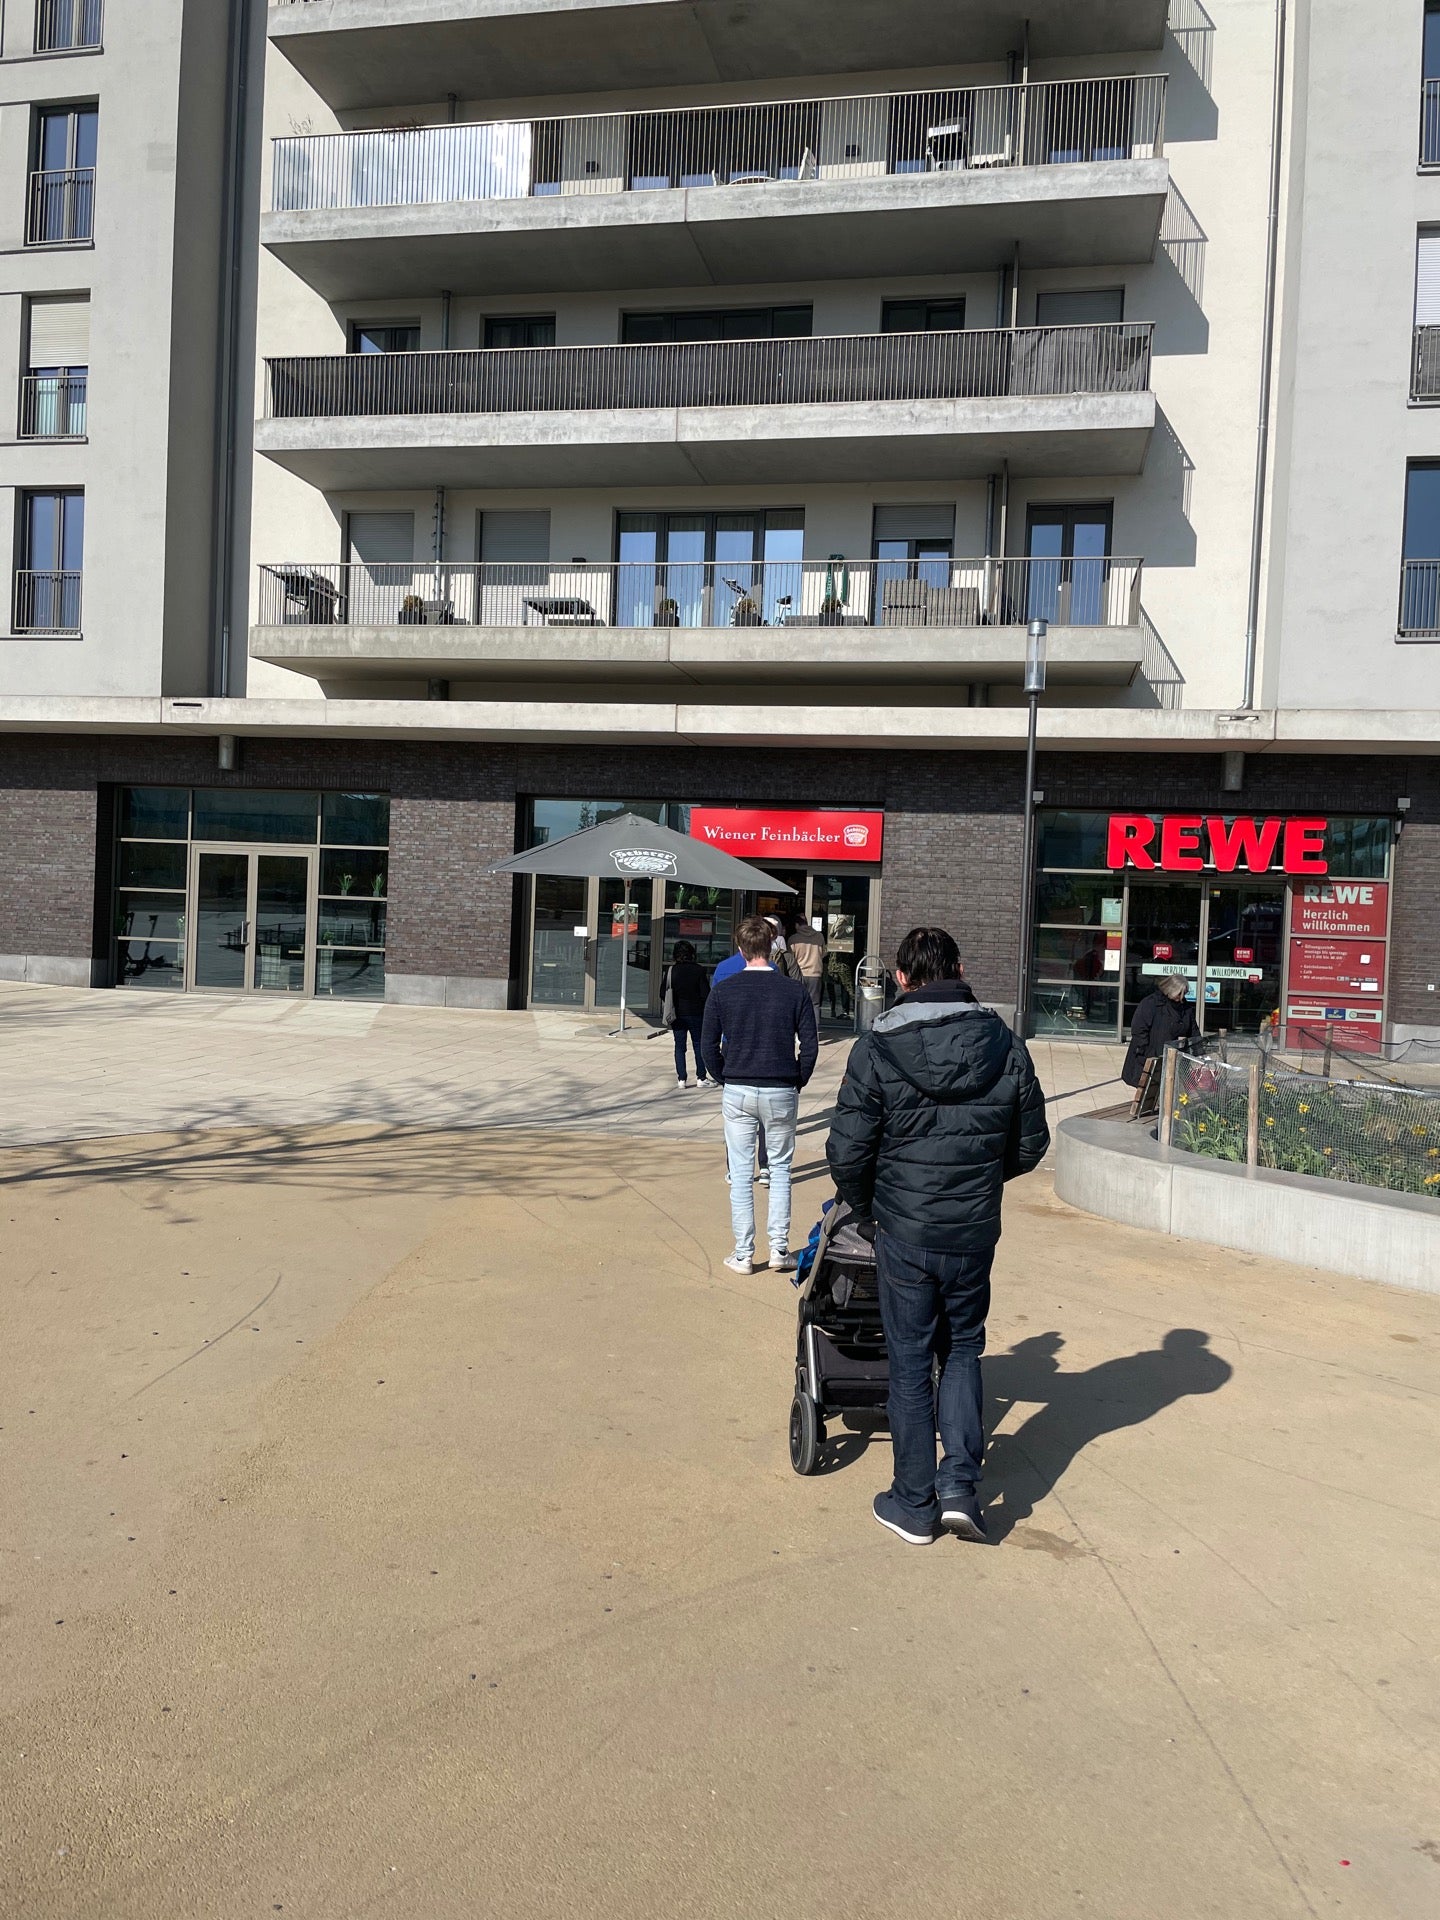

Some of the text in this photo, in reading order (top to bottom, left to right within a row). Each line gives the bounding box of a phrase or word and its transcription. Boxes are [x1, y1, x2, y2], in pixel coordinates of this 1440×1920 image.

[704, 825, 841, 844] Wiener Feinbäcker
[1107, 813, 1328, 874] REWE
[1303, 885, 1374, 905] REWE
[1302, 909, 1349, 921] Herzlich
[1302, 920, 1370, 933] willkommen
[1162, 965, 1188, 976] HERZLICH
[1211, 968, 1247, 978] WILLKOMMEN
